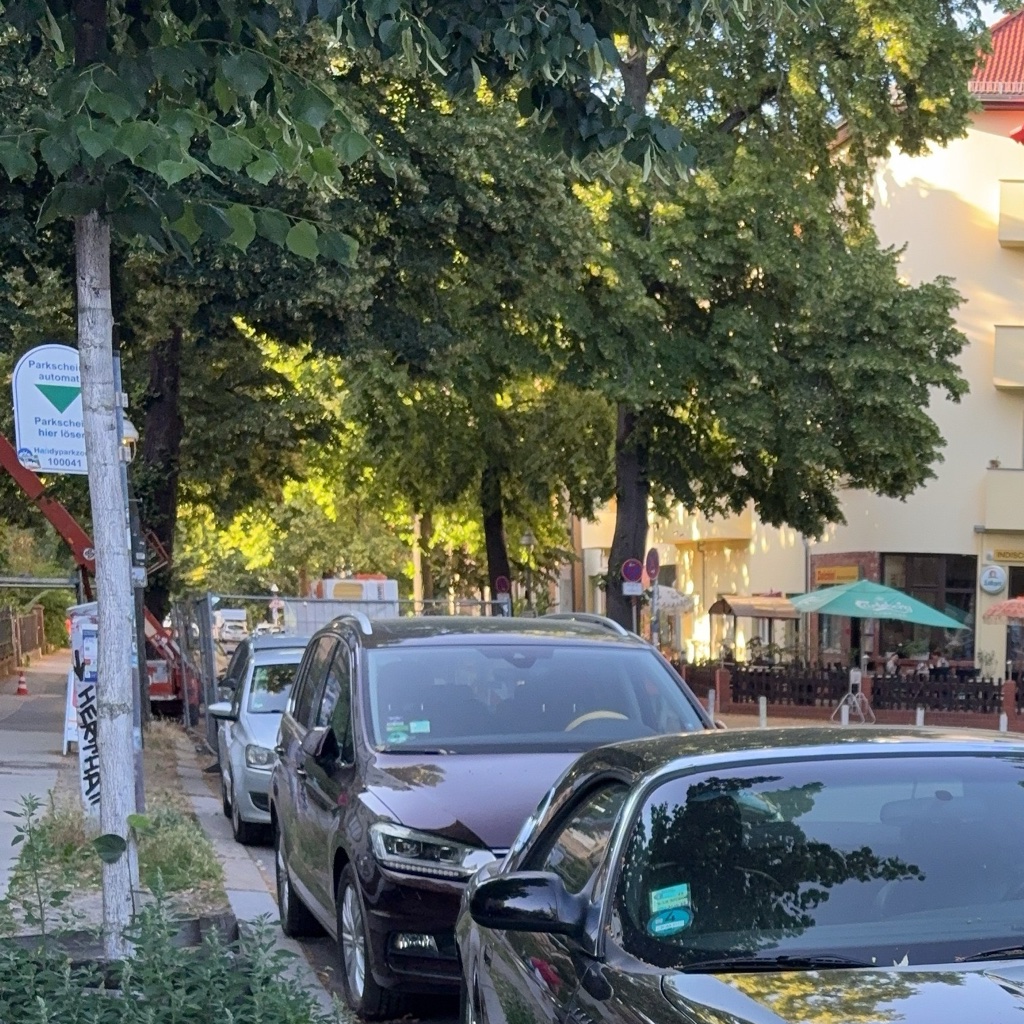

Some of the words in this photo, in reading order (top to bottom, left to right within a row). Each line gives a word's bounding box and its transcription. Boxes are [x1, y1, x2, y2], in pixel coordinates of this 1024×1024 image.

[28, 360, 80, 372] Parkschei
[38, 373, 80, 383] automat
[34, 416, 84, 428] Parkschei
[38, 428, 57, 438] hier
[34, 447, 87, 457] Handyparkzo
[47, 458, 82, 467] 100041
